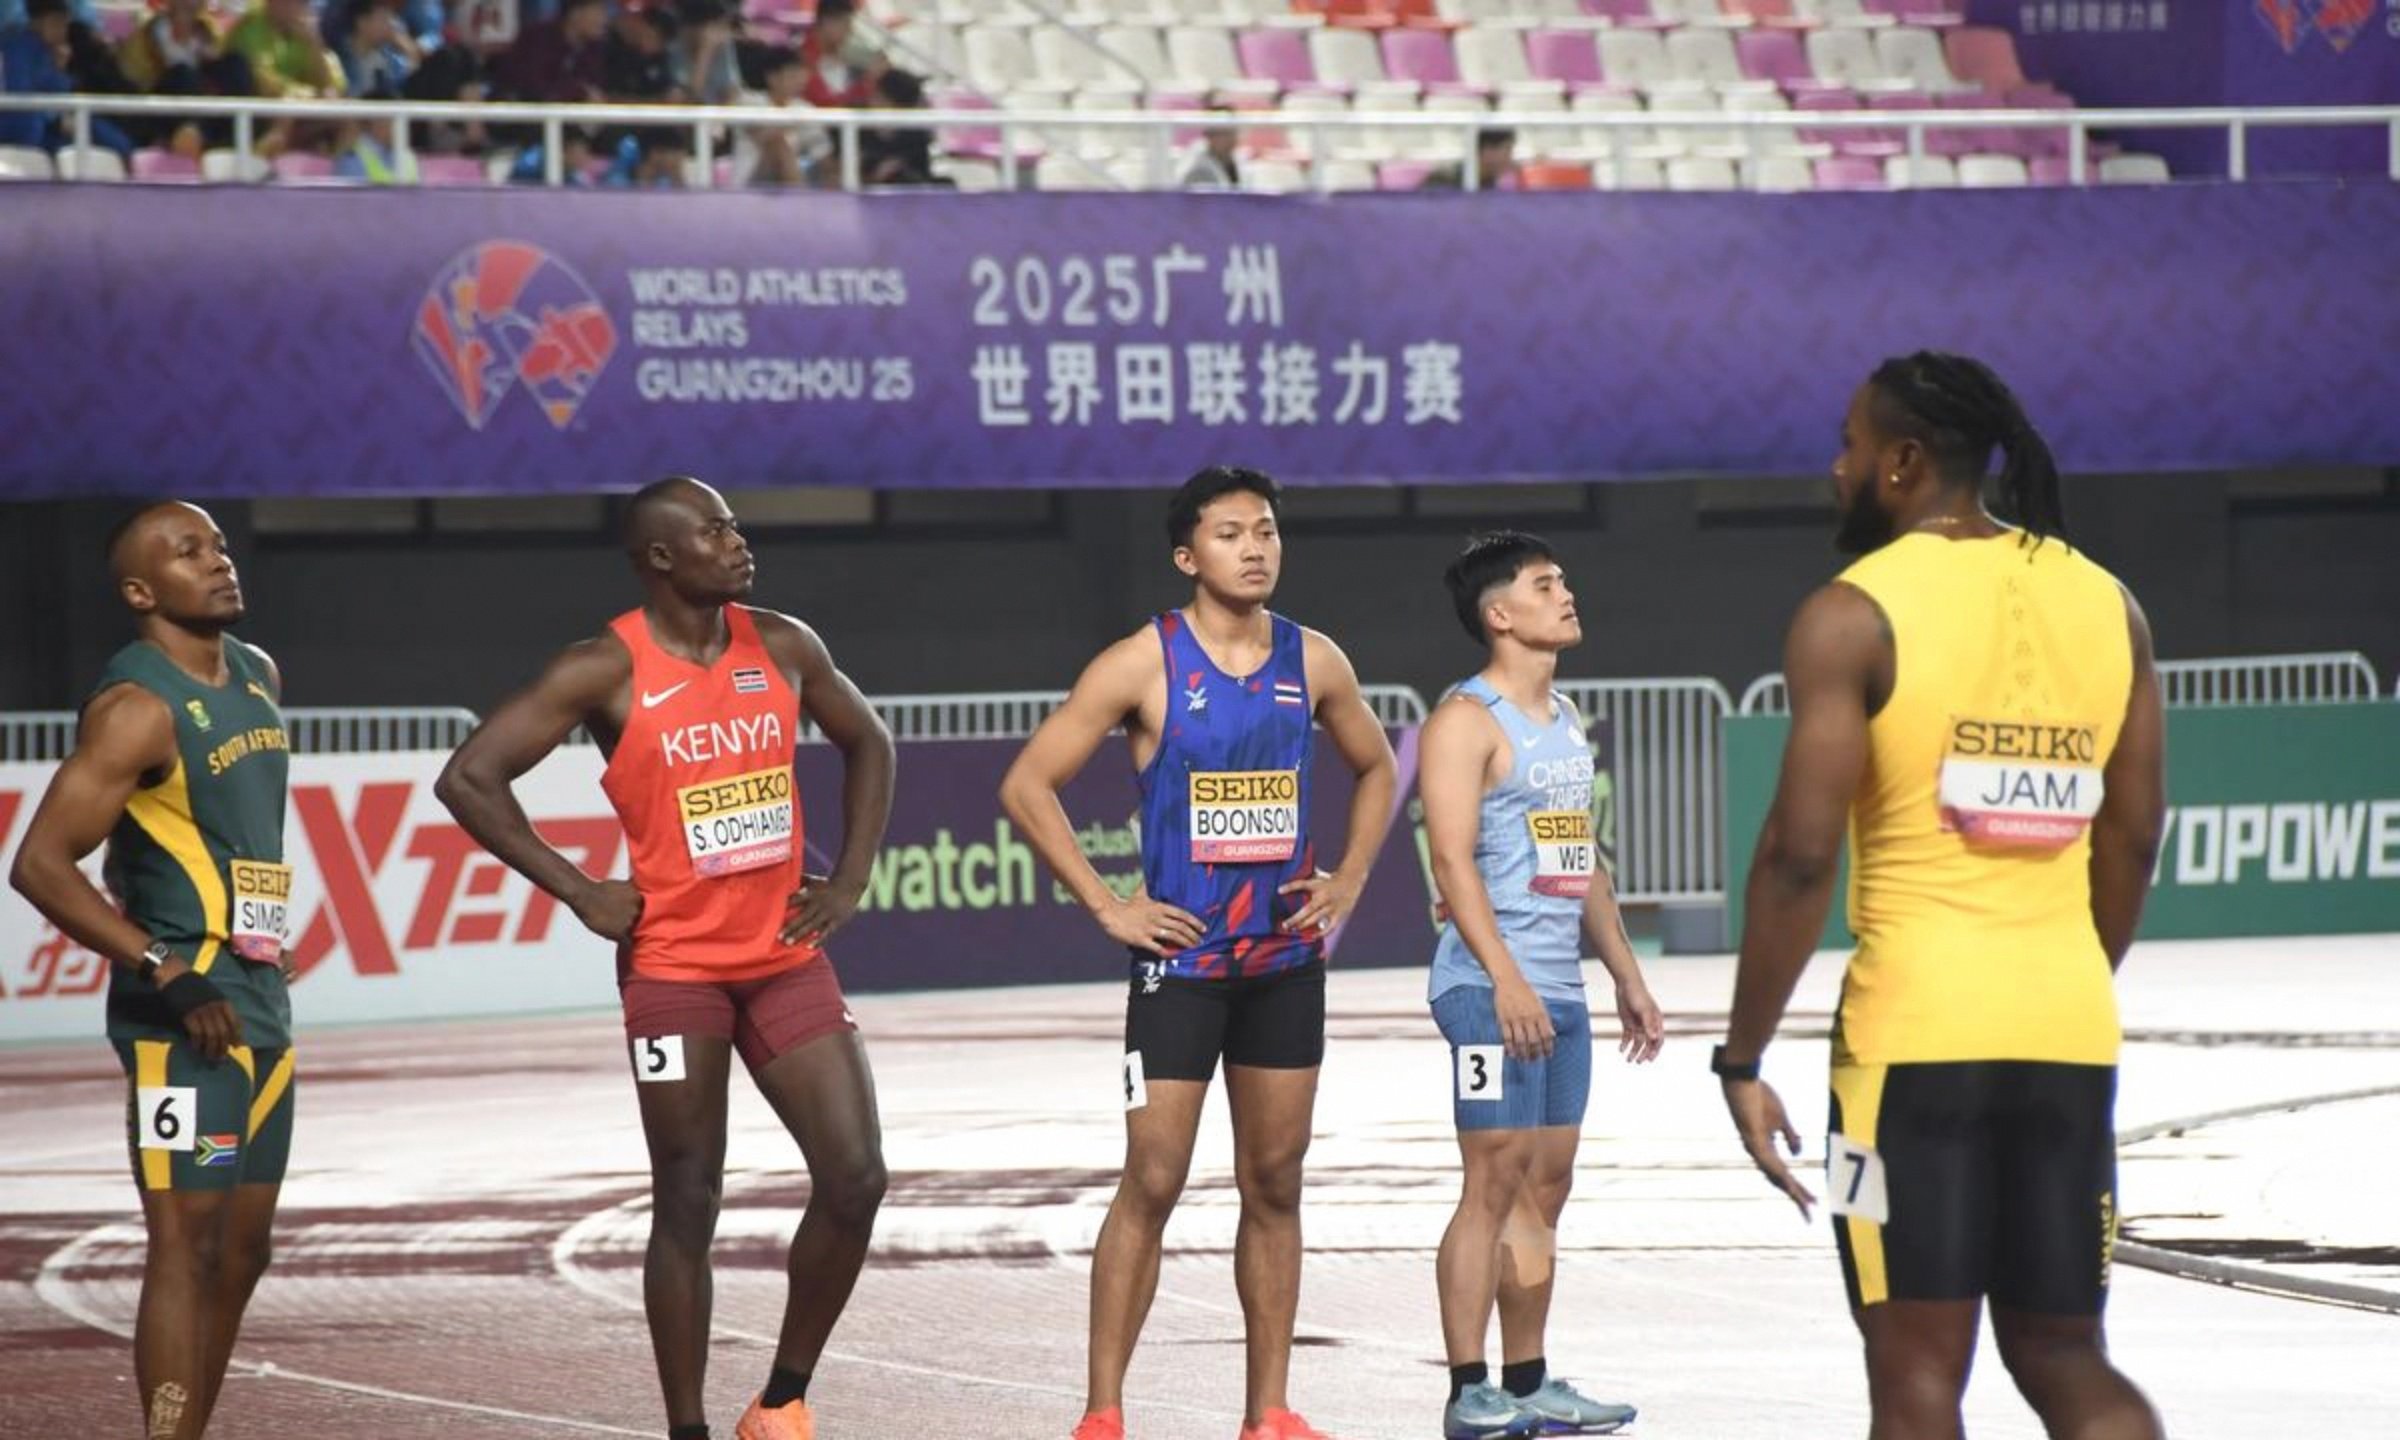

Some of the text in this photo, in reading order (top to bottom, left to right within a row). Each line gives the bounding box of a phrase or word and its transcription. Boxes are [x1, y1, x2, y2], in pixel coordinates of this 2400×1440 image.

[629, 266, 907, 306] WORLD ATHLETICS
[971, 244, 1284, 328] 2025广州
[631, 310, 749, 348] RELAYS
[636, 356, 914, 401] GUANGZHOU 25
[971, 340, 1463, 426] 世界田联接力赛
[208, 734, 249, 775] SOUTH
[661, 712, 781, 767] KENYA
[1953, 721, 2094, 763] SEIKO
[1195, 775, 1294, 802] SEIKO
[1528, 755, 1594, 788] CHINES
[1981, 770, 2078, 811] JAM
[685, 772, 789, 817] SEIKO
[693, 823, 713, 851] S.
[1197, 808, 1295, 836] BOONSON
[1533, 815, 1592, 840] SEIK
[1559, 846, 1589, 871] WEI
[647, 1037, 667, 1073] 5
[1469, 1053, 1488, 1091] 3
[153, 1096, 180, 1140] 6
[1844, 1151, 1867, 1205] 7
